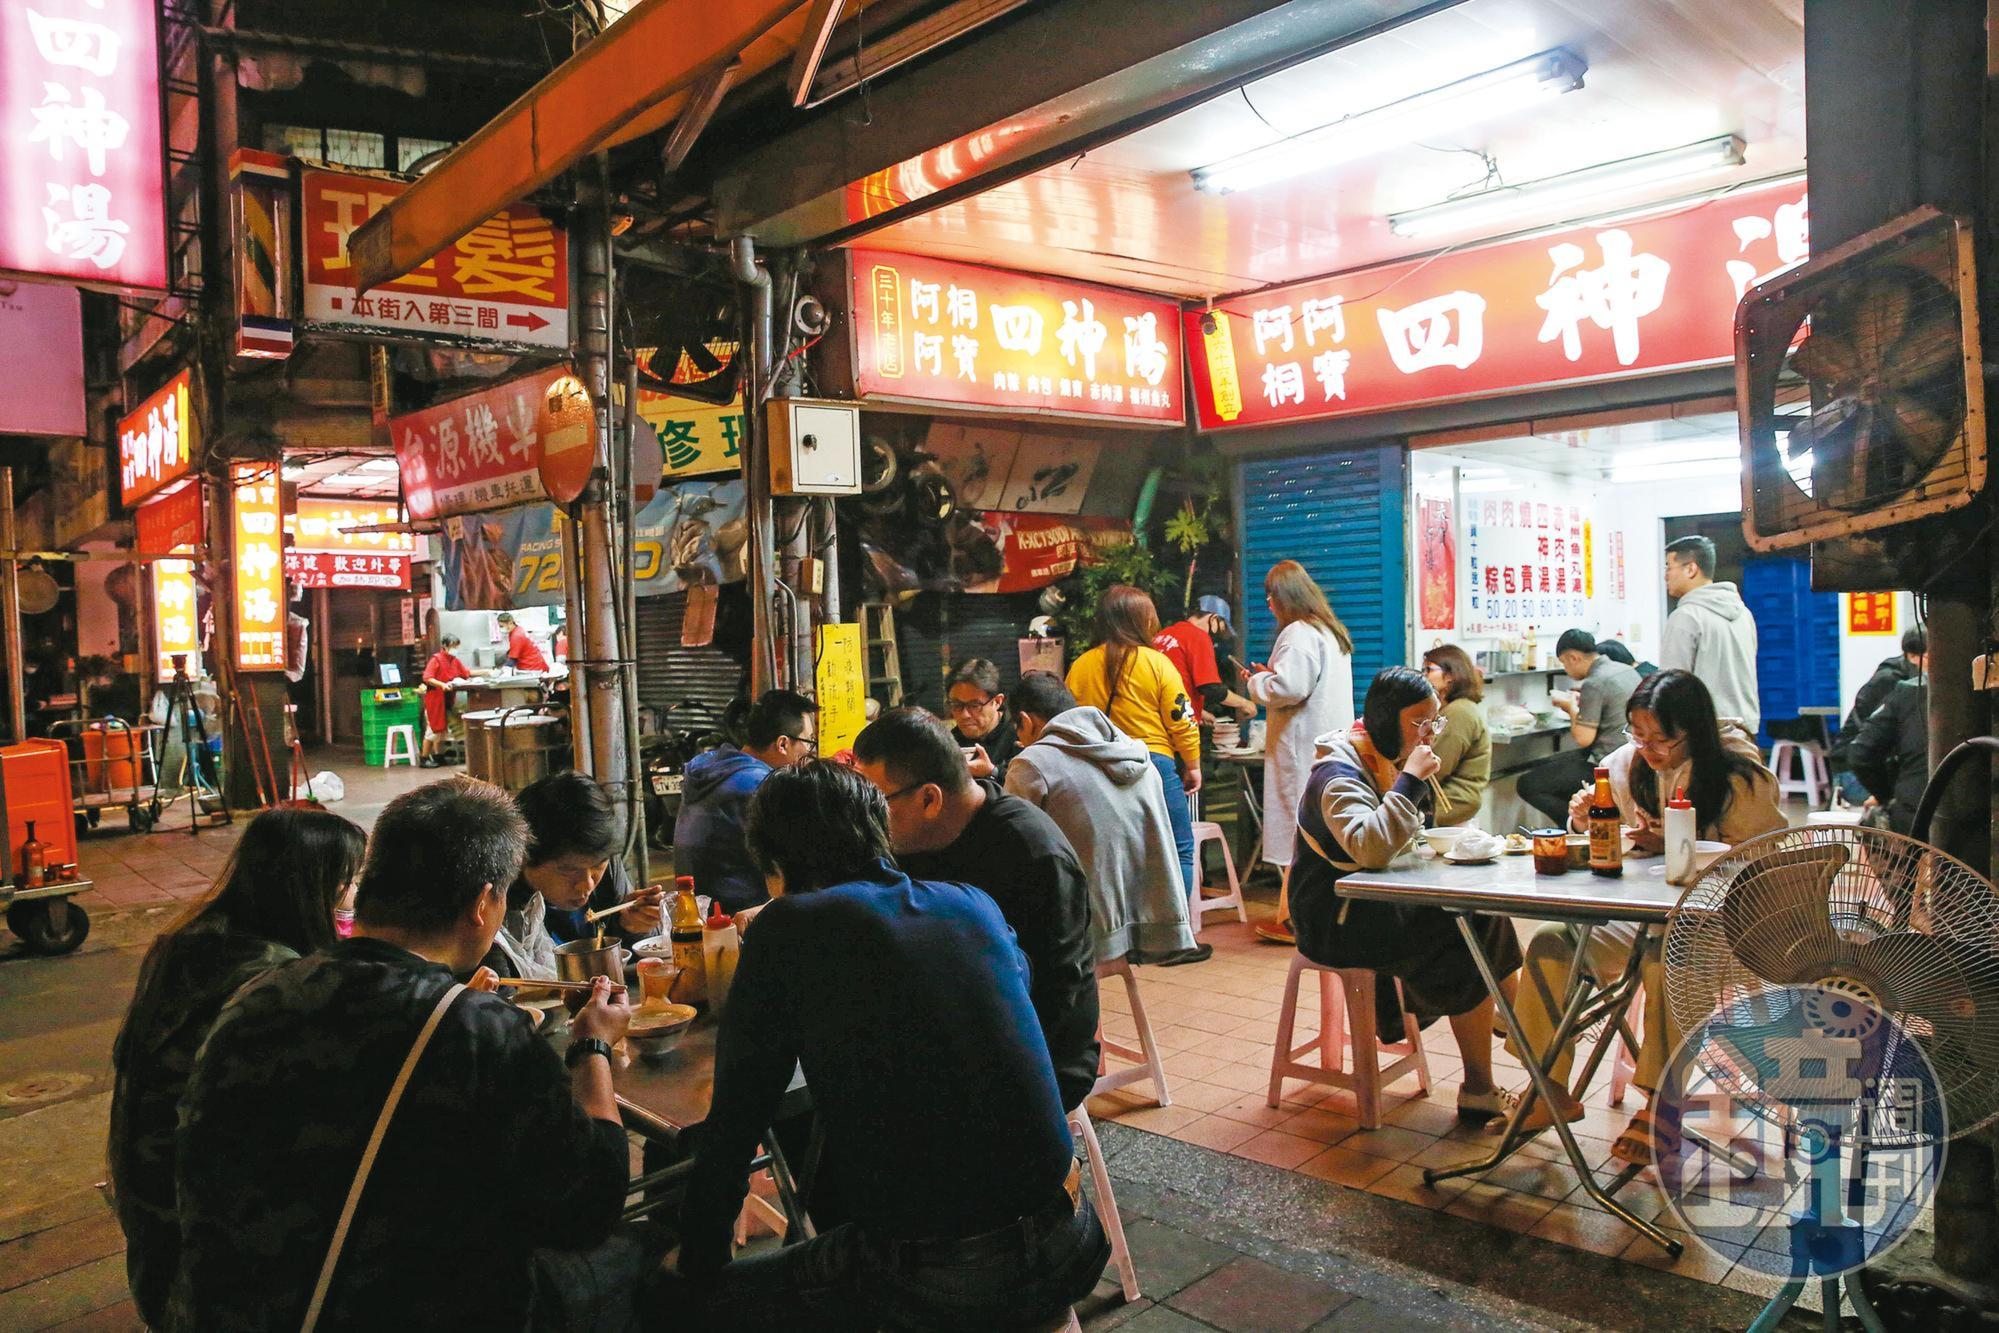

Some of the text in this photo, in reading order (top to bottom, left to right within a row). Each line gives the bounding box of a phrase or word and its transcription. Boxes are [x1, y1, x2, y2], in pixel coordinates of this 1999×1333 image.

[27, 8, 130, 268] 四神湯
[351, 297, 499, 329] 本街入第三間
[878, 274, 897, 373] 三十年老店
[989, 297, 1168, 386] 四神湯
[240, 511, 279, 624] 四神湯
[334, 556, 402, 574] 歡迎外帶
[1502, 499, 1516, 595] 肉包
[1487, 599, 1500, 619] 50
[1505, 599, 1517, 619] 20
